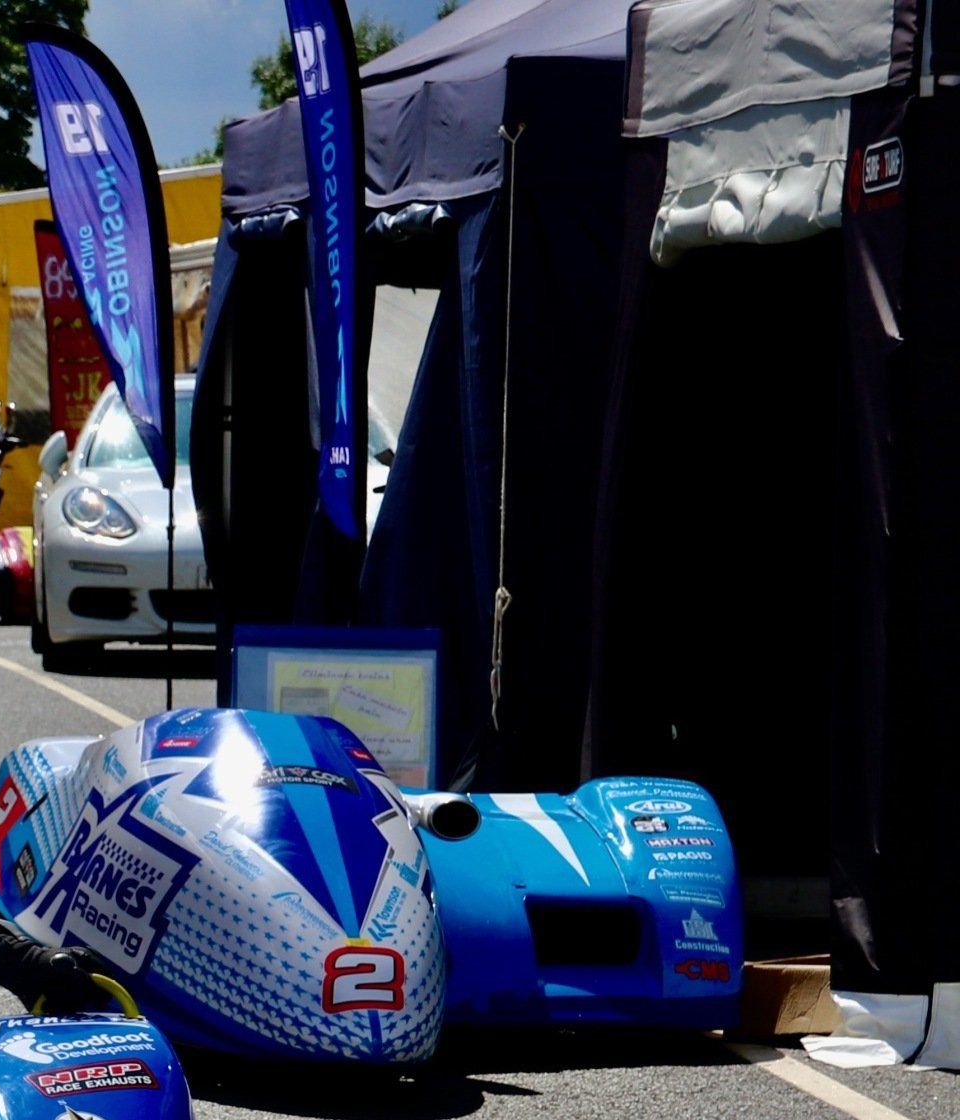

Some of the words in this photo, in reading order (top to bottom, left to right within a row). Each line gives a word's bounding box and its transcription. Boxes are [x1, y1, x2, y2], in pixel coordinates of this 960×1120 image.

[668, 851, 713, 861] PAGID
[50, 817, 156, 923] BARNES
[71, 888, 144, 958] Racing
[675, 939, 730, 955] Construction
[329, 950, 398, 1008] 2
[36, 1031, 155, 1054] Goodfoot
[52, 1043, 157, 1061] Development
[39, 1063, 142, 1088] NRP
[45, 1082, 80, 1095] RACE
[86, 1075, 153, 1089] EXHAUSTS
